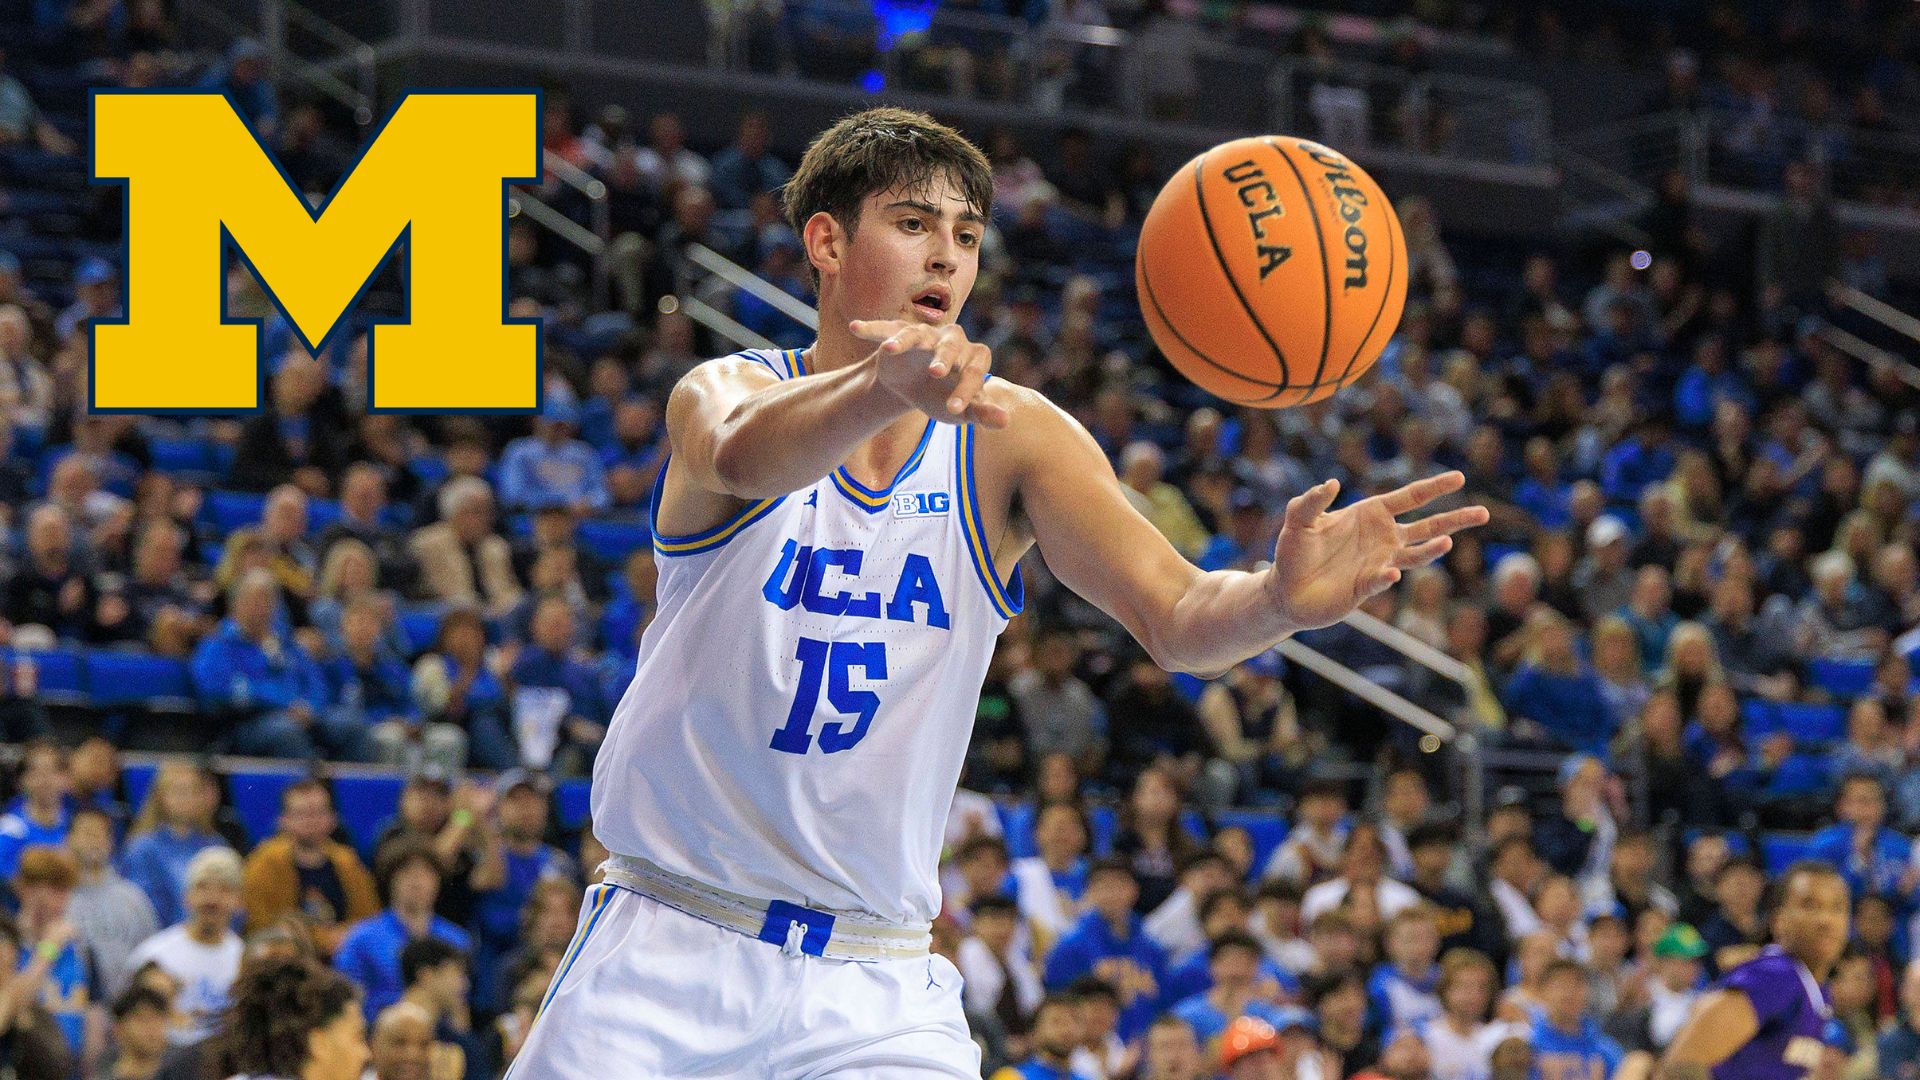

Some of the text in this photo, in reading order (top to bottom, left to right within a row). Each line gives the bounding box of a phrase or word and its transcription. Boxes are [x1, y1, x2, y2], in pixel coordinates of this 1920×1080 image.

[1222, 160, 1292, 280] UCLA
[1298, 144, 1368, 289] Wilson
[769, 637, 888, 754] 15
